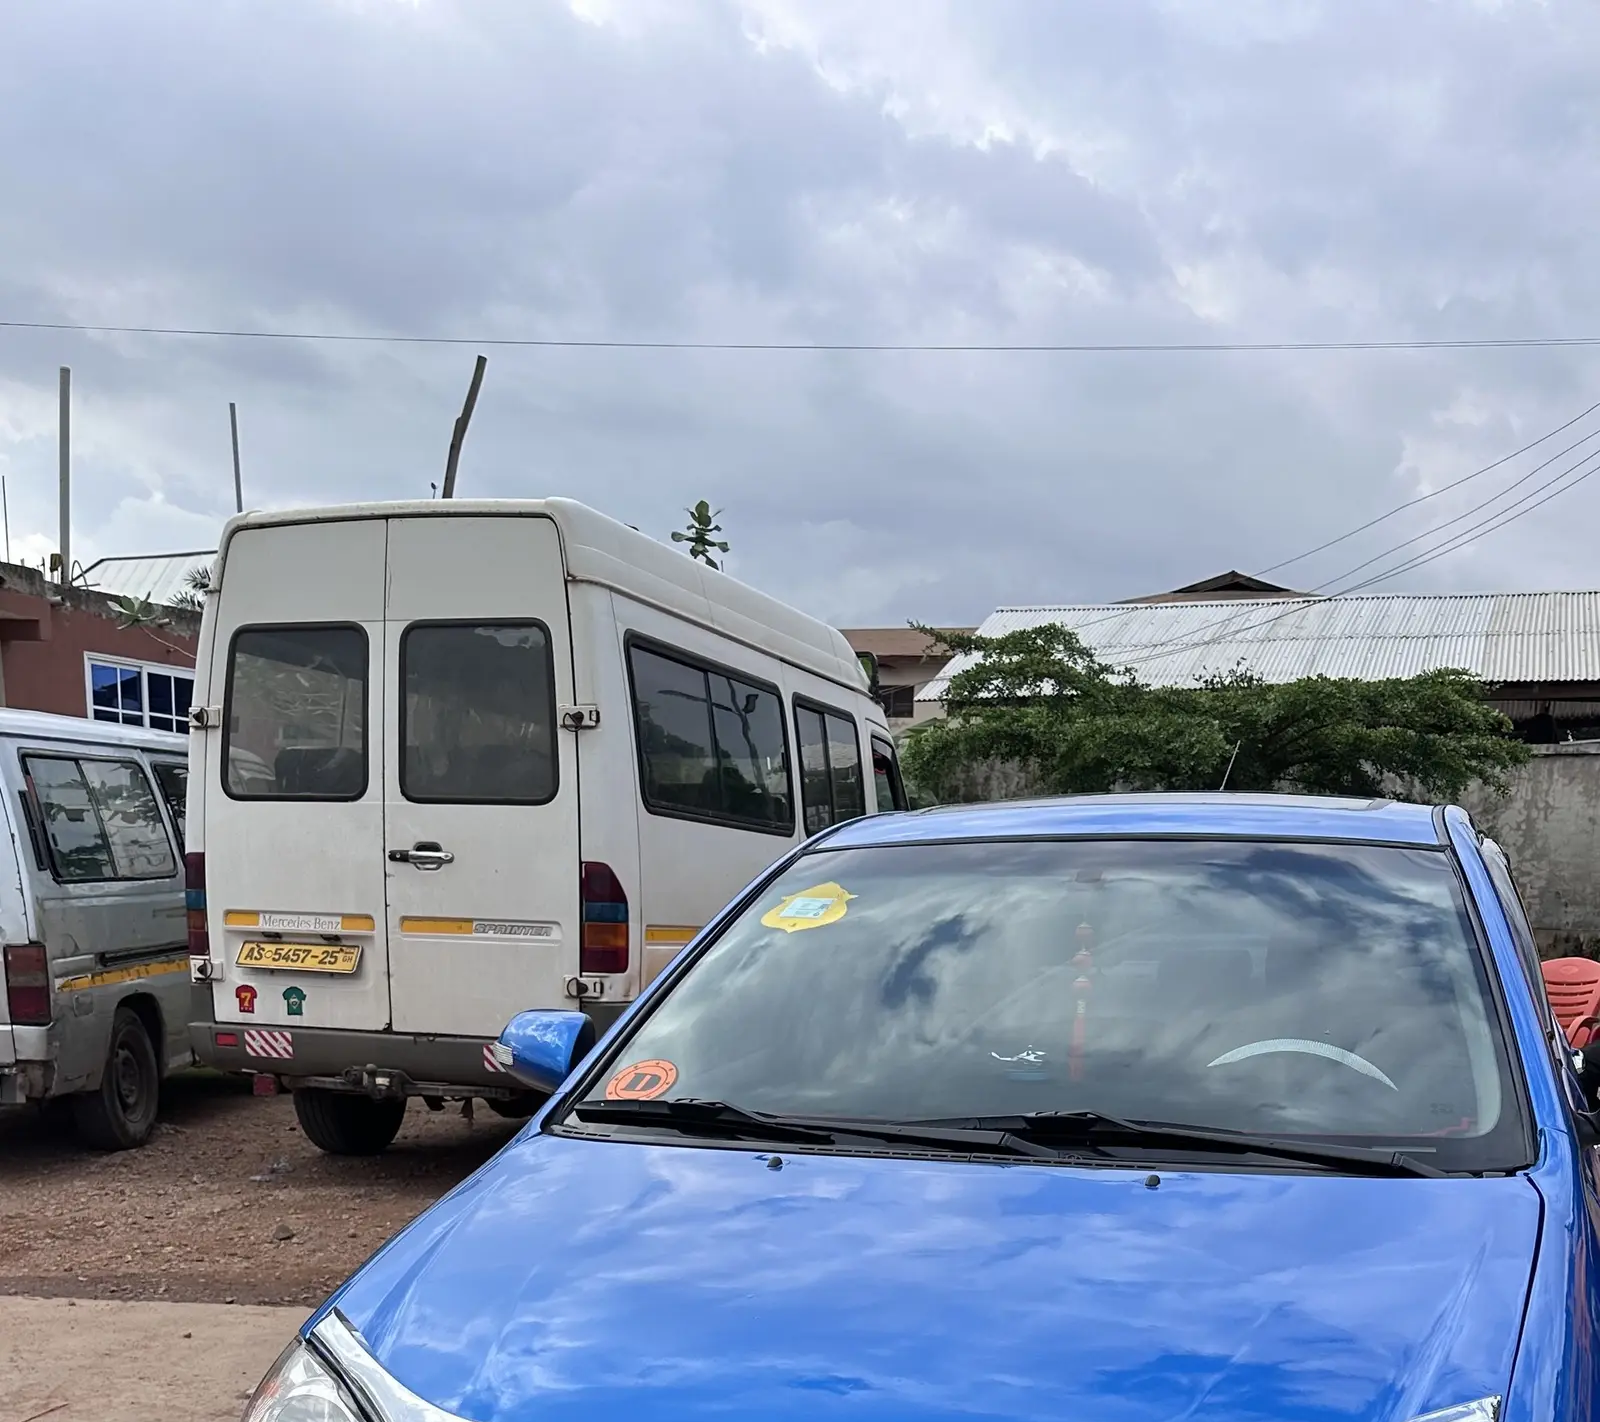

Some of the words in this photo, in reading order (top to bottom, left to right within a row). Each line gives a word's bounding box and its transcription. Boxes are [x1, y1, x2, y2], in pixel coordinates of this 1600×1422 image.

[261, 914, 311, 929] Mercedes
[313, 916, 341, 931] Benz
[473, 923, 553, 937] SPRINTER
[243, 946, 265, 961] AS
[272, 948, 339, 966] 5457-25
[342, 955, 353, 964] GH
[241, 992, 252, 1007] 7
